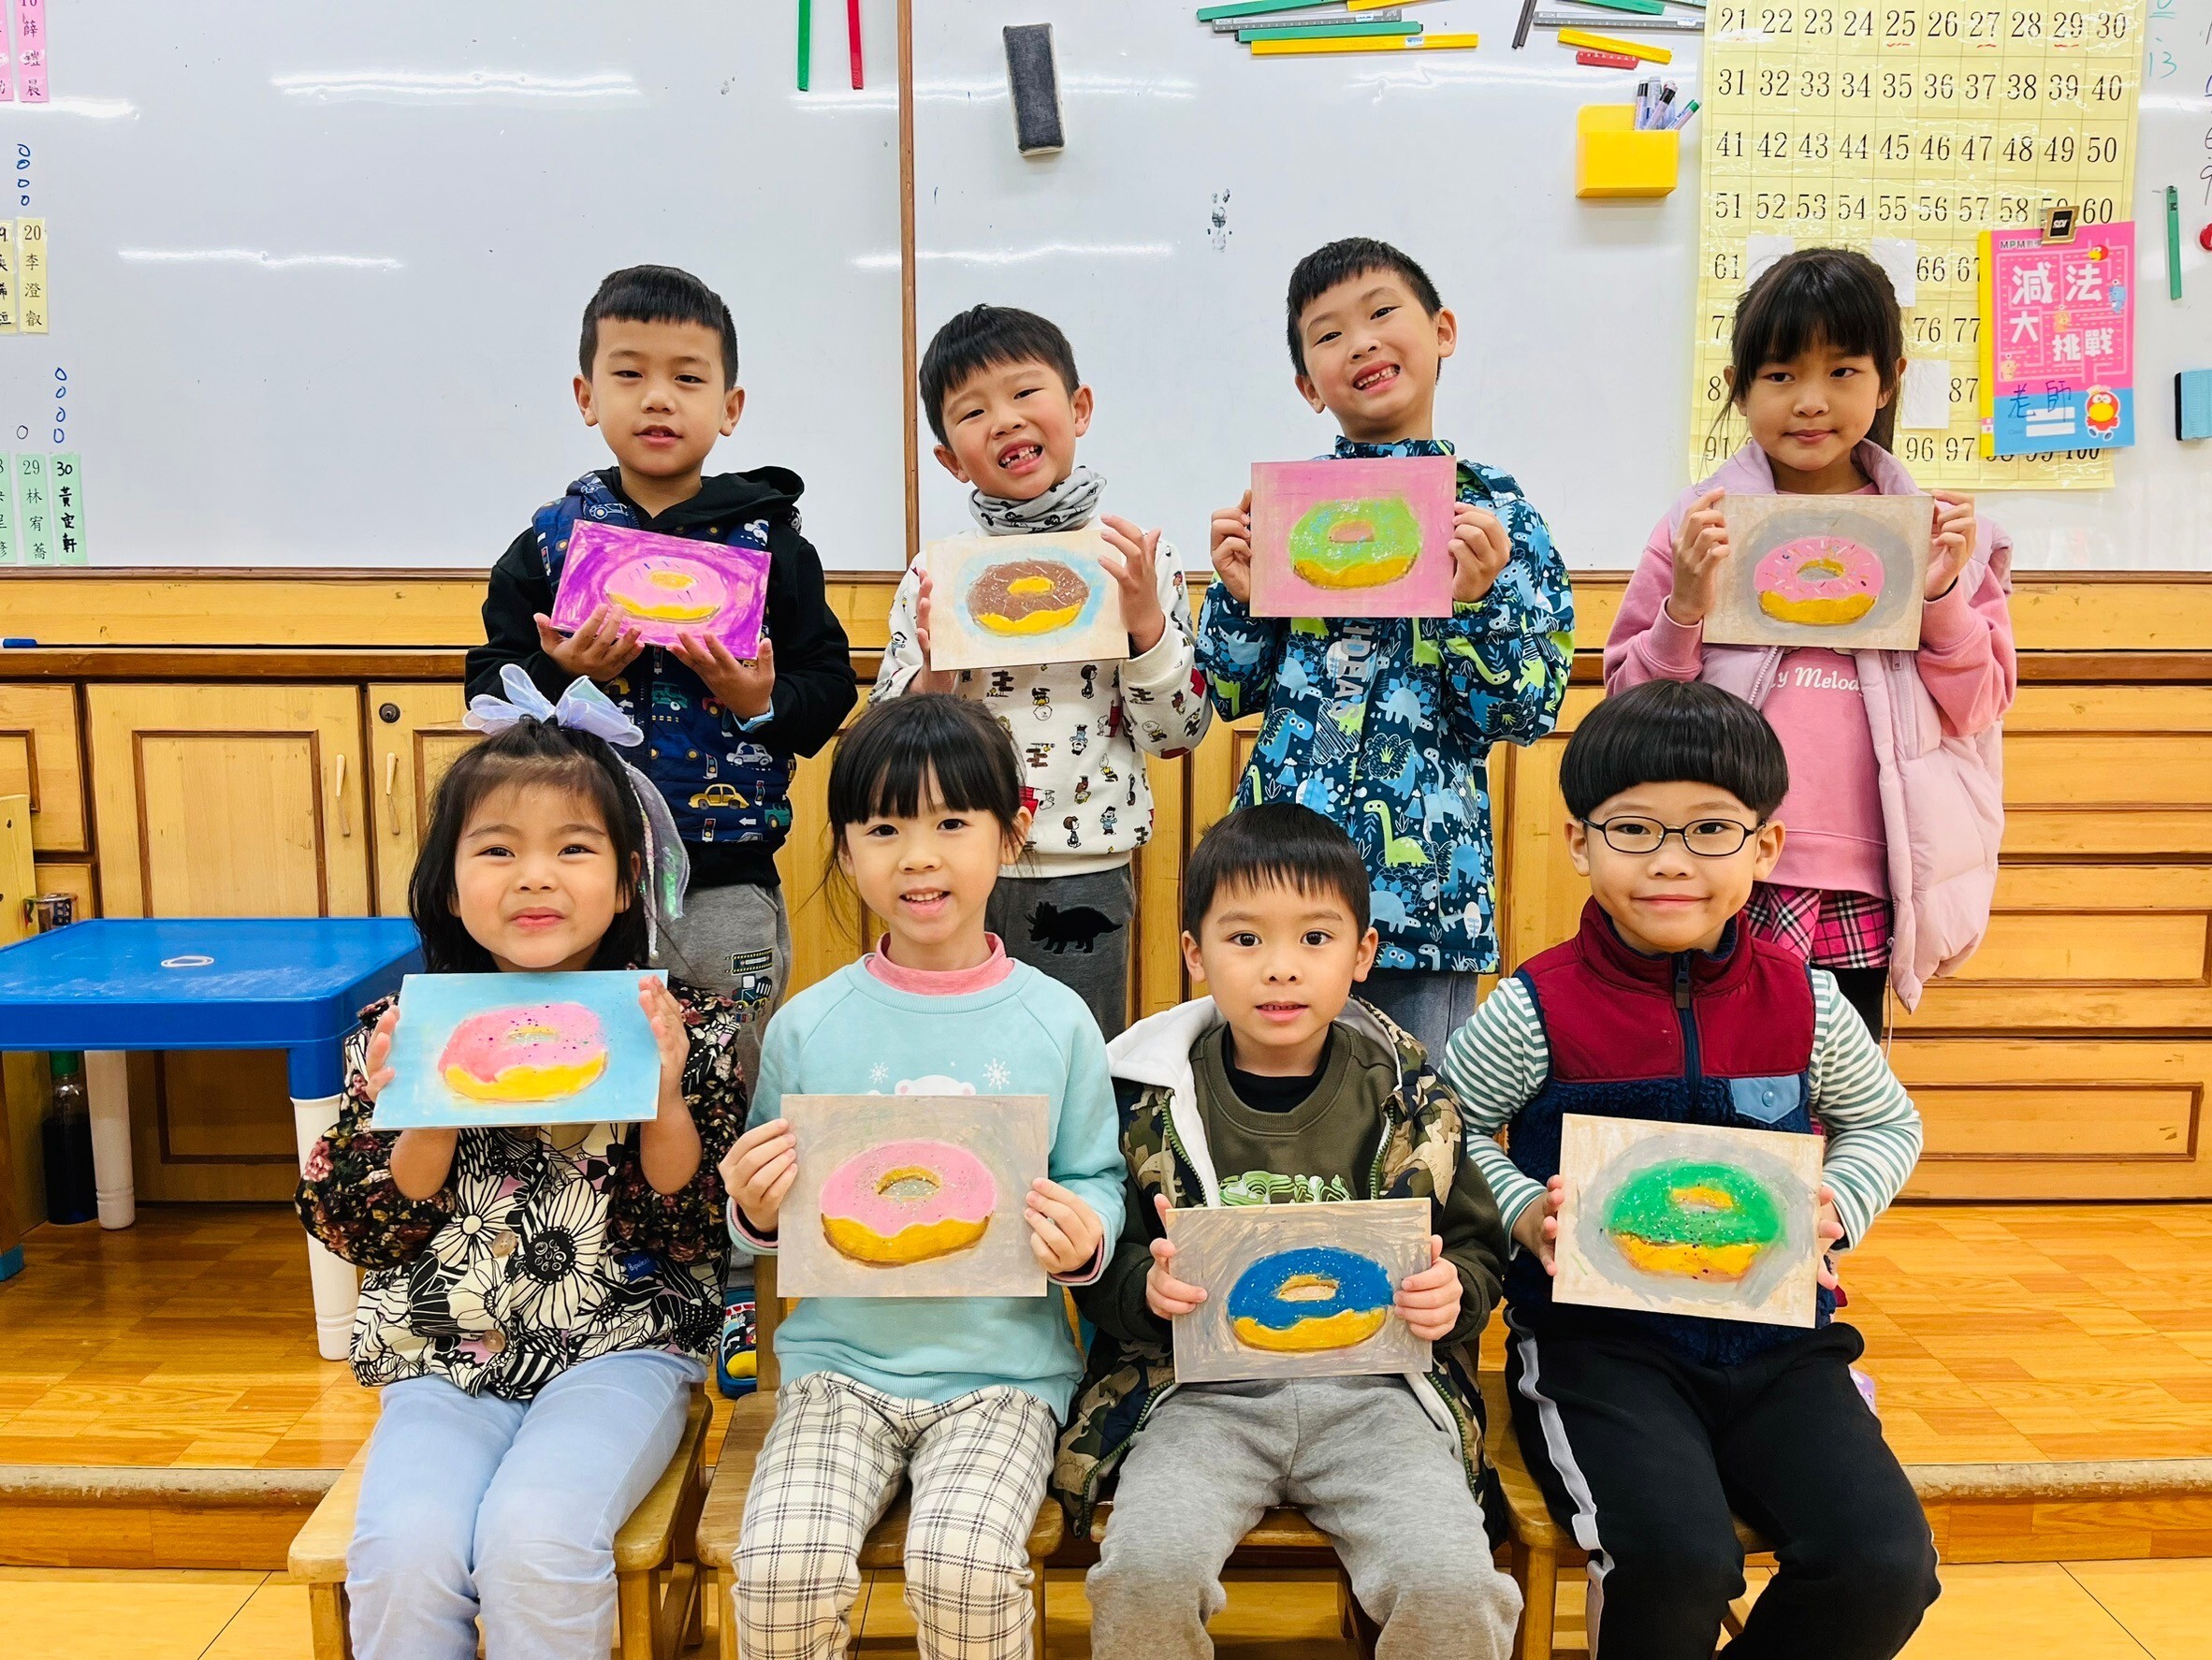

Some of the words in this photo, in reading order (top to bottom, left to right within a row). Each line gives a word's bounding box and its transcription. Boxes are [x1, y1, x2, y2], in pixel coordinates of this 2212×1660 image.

[1721, 8, 1746, 33] 21
[1763, 10, 1793, 34] 22
[1805, 9, 1832, 34] 23
[1844, 11, 1873, 36] 24
[1886, 10, 1915, 36] 25
[1928, 11, 1957, 36] 26
[1971, 12, 2000, 36] 27
[2012, 13, 2041, 36] 28
[2055, 12, 2083, 37] 29
[2097, 15, 2127, 38] 30
[1719, 69, 1745, 95] 31
[1760, 71, 1789, 95] 32
[1802, 72, 1829, 96] 33
[1842, 74, 1870, 97] 34
[1884, 74, 1912, 97] 35
[1925, 74, 1953, 98] 36
[1967, 75, 1996, 99] 37
[2008, 75, 2036, 99] 38
[2049, 75, 2078, 99] 39
[2091, 76, 2122, 100] 40
[1717, 132, 1743, 156] 41
[1757, 133, 1787, 157] 42
[1798, 133, 1828, 158] 43
[1840, 135, 1869, 158] 44
[1881, 135, 1909, 159] 45
[1921, 138, 1950, 160] 46
[1962, 137, 1992, 160] 47
[2003, 137, 2032, 161] 48
[2045, 137, 2074, 162] 49
[2088, 138, 2117, 162] 50
[1716, 194, 1741, 218] 51
[1757, 194, 1785, 219] 52
[1797, 195, 1826, 219] 53
[1838, 196, 1866, 219] 54
[1880, 196, 1907, 220] 55
[1919, 197, 1947, 221] 56
[1960, 197, 1988, 221] 57
[2001, 198, 2028, 222] 58
[2084, 198, 2112, 224] 60
[24, 225, 41, 240] 20
[1714, 254, 1740, 279] 61
[1917, 256, 1945, 282] 66
[2012, 261, 2103, 305] 減法
[1914, 317, 1941, 342] 76
[1954, 318, 1980, 342] 77
[1949, 378, 1978, 402] 87
[2007, 380, 2072, 422] 老師
[1705, 436, 1729, 460] 91
[1906, 437, 1933, 461] 96
[1945, 437, 1975, 461] 97
[23, 459, 40, 474] 29
[57, 461, 73, 476] 30
[1795, 666, 1865, 698] Melod
